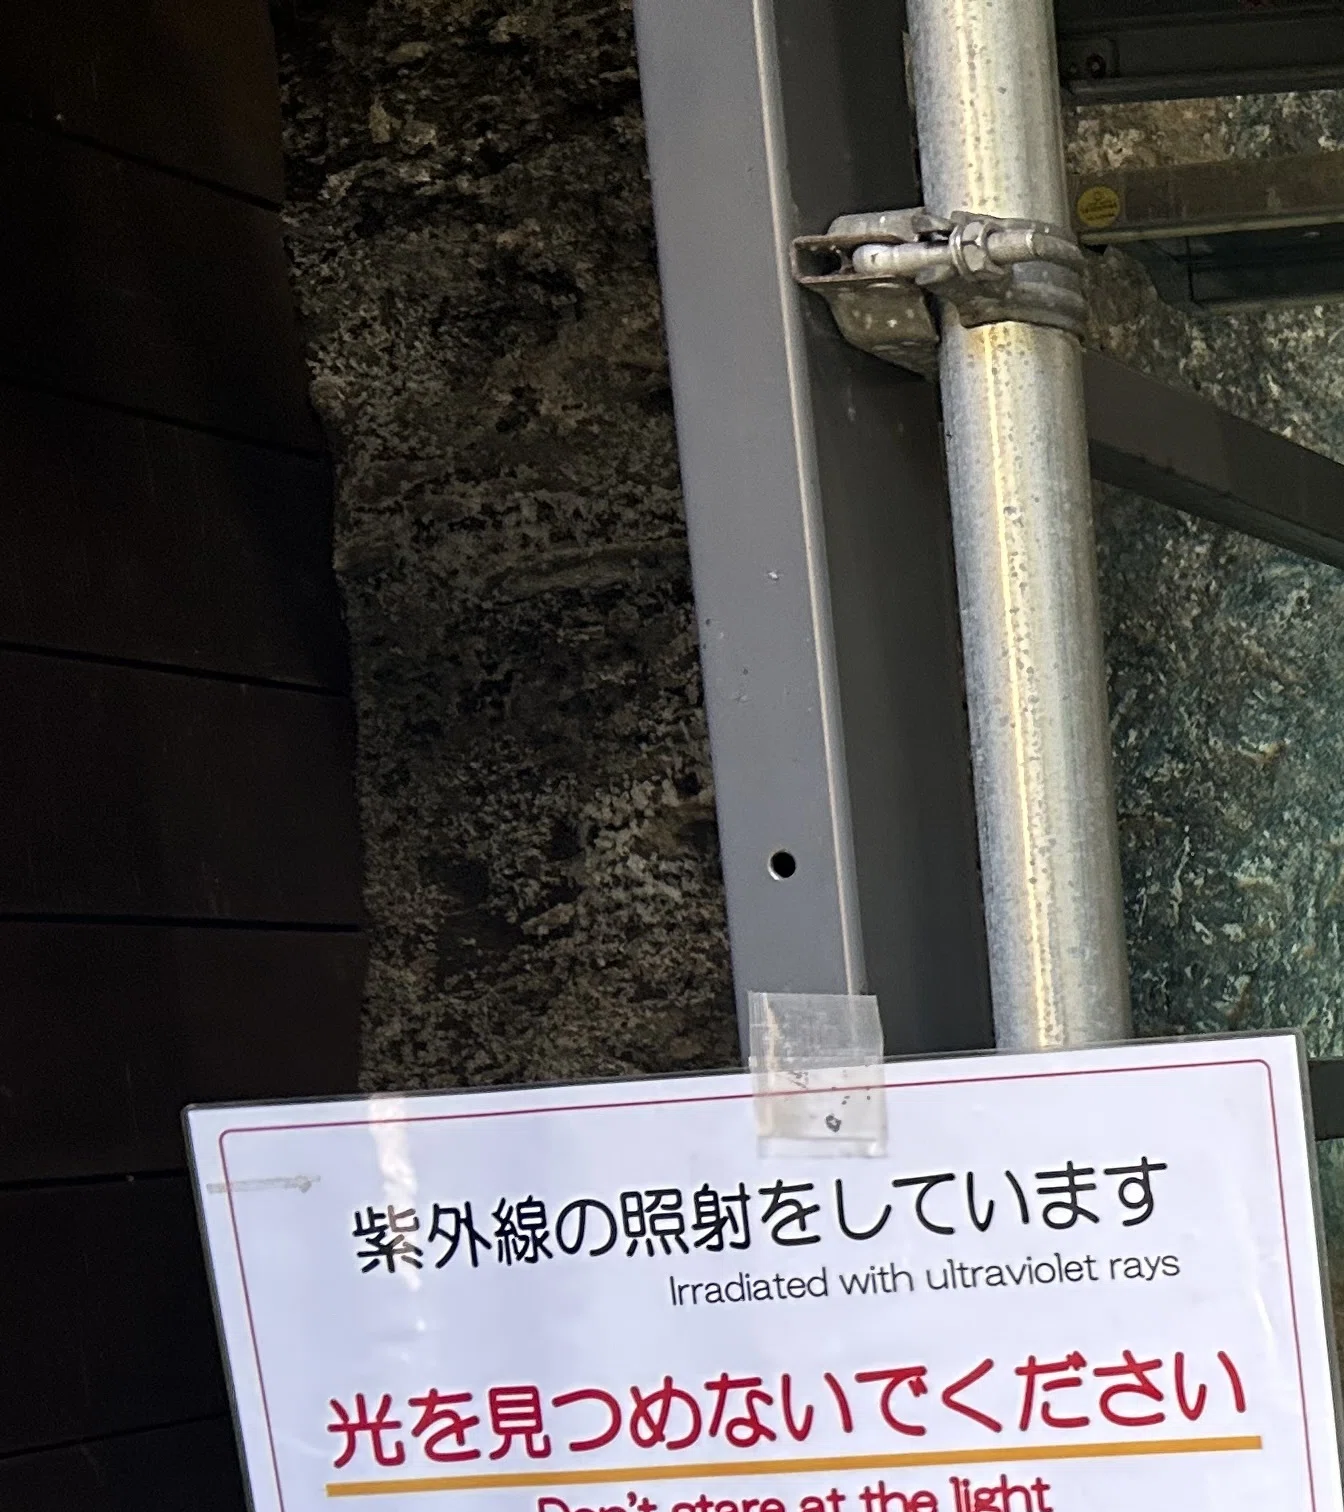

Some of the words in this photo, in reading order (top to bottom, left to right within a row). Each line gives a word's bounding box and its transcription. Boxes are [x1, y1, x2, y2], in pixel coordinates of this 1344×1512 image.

[352, 1154, 1168, 1274] 紫外線の照射をしています
[668, 1266, 830, 1307] Irradiated
[838, 1261, 916, 1297] with
[925, 1251, 1100, 1291] ultraviolet
[1108, 1253, 1182, 1285] rays
[326, 1349, 1247, 1469] 光を見つめないでください
